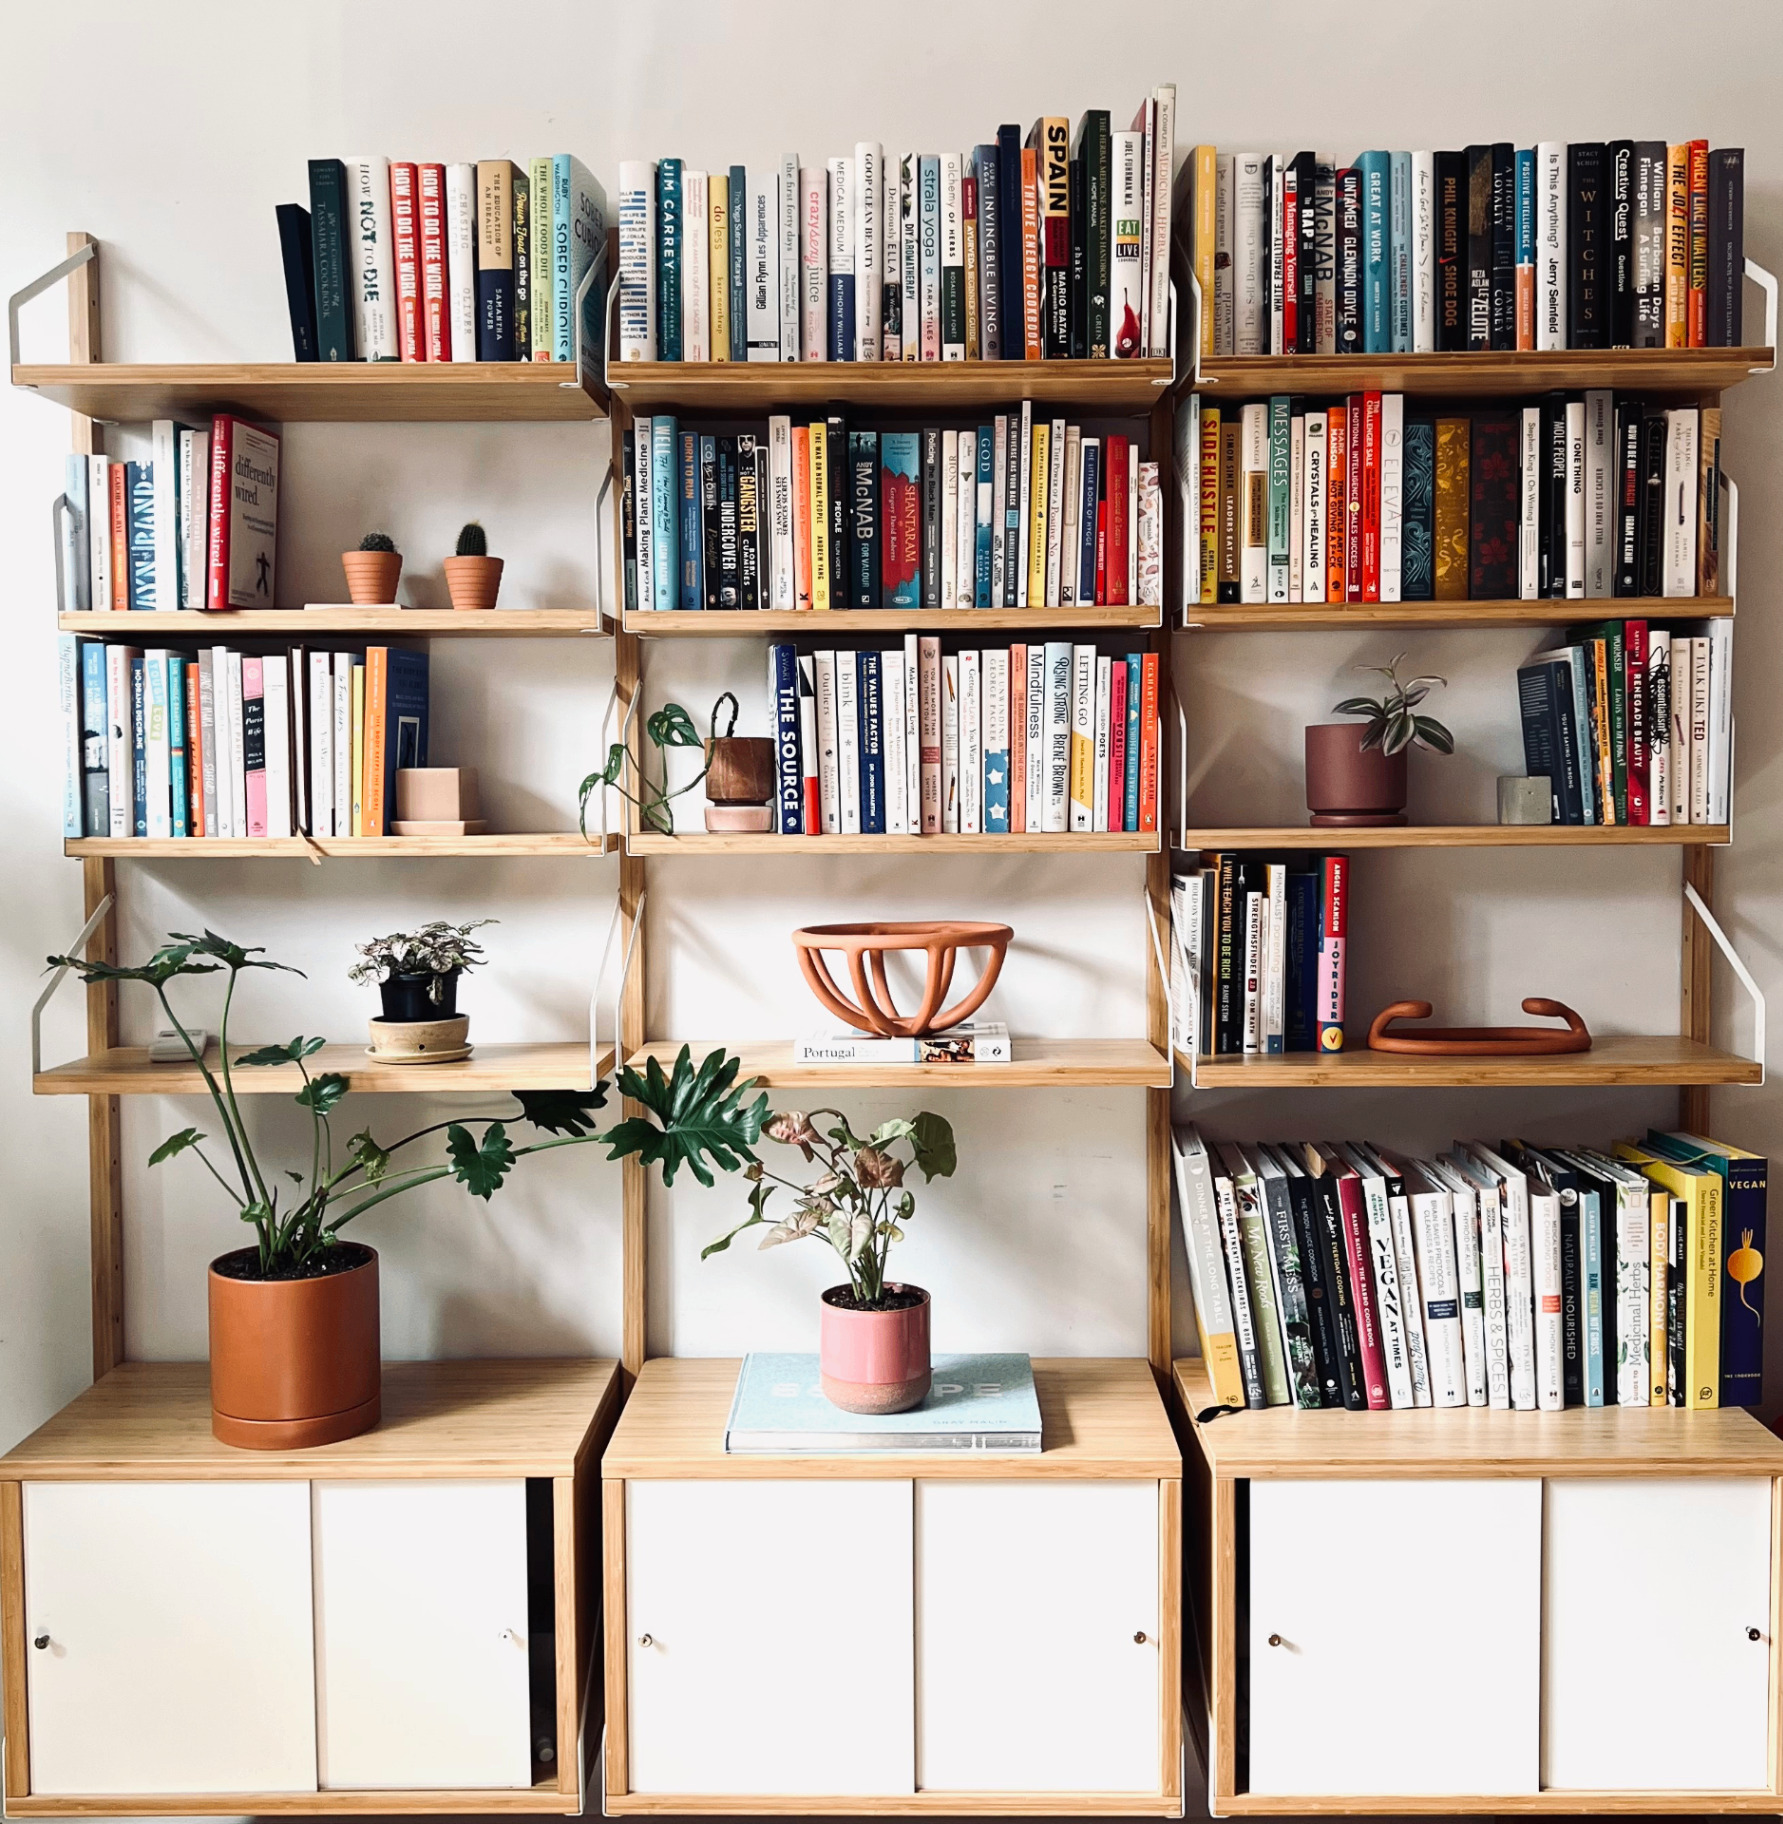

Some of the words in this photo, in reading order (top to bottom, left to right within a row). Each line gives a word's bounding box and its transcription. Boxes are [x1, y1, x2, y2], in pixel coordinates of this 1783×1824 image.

[865, 154, 873, 185] GOOP
[1048, 125, 1066, 211] SPAIN
[1550, 154, 1558, 163] Is
[1618, 149, 1629, 200] Creative
[360, 164, 371, 197] HOW
[395, 168, 410, 196] HOW
[664, 162, 674, 191] JIM
[837, 162, 845, 207] MEDICAL
[925, 169, 936, 212] strala
[1371, 172, 1380, 207] GREAT
[1444, 177, 1456, 204] PHIL
[1550, 167, 1558, 190] This
[1638, 158, 1650, 216] Finnegan
[1653, 161, 1663, 211] William
[396, 199, 411, 215] TO
[714, 206, 724, 222] do
[756, 195, 766, 242] Apparences
[865, 188, 873, 223] CLEAN
[1024, 184, 1036, 228] THRIVE
[1344, 177, 1356, 228] UNTAMED
[1372, 212, 1381, 224] AT
[361, 201, 376, 243] NOT
[397, 218, 412, 234] DO
[664, 200, 674, 269] CARREY
[715, 226, 724, 249] less
[921, 218, 935, 257] yoga
[985, 196, 996, 277] INVINCIBLE
[1117, 220, 1139, 235] EAT
[1286, 202, 1296, 255] Managing
[1445, 207, 1456, 253] KNIGHT
[1548, 194, 1558, 248] Anything?
[1618, 203, 1629, 240] Quest
[364, 245, 373, 265] TO
[398, 237, 413, 259] THE
[756, 244, 765, 259] Les
[1117, 244, 1139, 257] LIVE
[1316, 197, 1333, 281] McNAB
[1371, 230, 1381, 262] WORK
[1640, 234, 1649, 243] A
[756, 261, 766, 283] Flynn
[1025, 234, 1036, 279] ENERGY
[1345, 237, 1355, 287] GLENNON
[1547, 258, 1558, 286] Jerry
[1637, 248, 1649, 294] Surfing
[1653, 227, 1662, 292] Barbarian
[363, 268, 379, 302] DIE
[400, 262, 416, 299] WORK
[1287, 257, 1296, 303] Yourself
[1445, 265, 1456, 296] SHOE
[756, 285, 766, 309] Gillian
[986, 284, 997, 333] LIVING
[1344, 291, 1356, 324] DOYLE
[1445, 300, 1456, 326] DOG
[1550, 289, 1558, 333] Seinfeld
[1639, 298, 1649, 321] Life
[1651, 297, 1661, 328] Days
[1027, 284, 1037, 347] COOKBOOK
[685, 436, 693, 462] BORN
[1202, 420, 1217, 461] SIDE
[1274, 404, 1287, 487] MESSAGES
[1527, 423, 1535, 452] Stephen
[1553, 421, 1564, 446] MOLE
[685, 465, 693, 476] TO
[981, 438, 990, 472] GOD
[1526, 455, 1534, 472] King
[1553, 448, 1564, 478] PEOPLE
[211, 445, 225, 520] differently
[685, 479, 693, 499] RUN
[1311, 451, 1319, 508] CRYSTALS
[1528, 480, 1534, 491] On
[640, 498, 648, 525] Plant
[856, 468, 873, 539] McNAB
[888, 487, 896, 513] Gregory
[1202, 466, 1216, 533] HUSTLE
[1383, 459, 1402, 545] ELEVATE
[1526, 494, 1534, 521] Writing
[721, 501, 736, 570] UNDERCOVER
[905, 485, 915, 563] SHANTARAM
[212, 527, 223, 567] wired
[640, 530, 648, 567] Making
[1310, 519, 1319, 568] HEALING
[1053, 657, 1069, 689] RISING
[1079, 655, 1088, 704] LETTING
[1695, 656, 1705, 687] TALK
[780, 687, 793, 722] THE
[822, 673, 831, 715] Outliers
[841, 673, 852, 707] blink
[869, 678, 877, 715] VALUES
[1030, 654, 1042, 738] Mindfulness
[1695, 689, 1704, 718] LIKE
[1053, 692, 1068, 724] STRONG
[1079, 708, 1087, 726] GO
[870, 719, 878, 754] FACTOR
[1694, 720, 1705, 740] TED
[1053, 734, 1067, 761] BRENÉ
[783, 731, 798, 810] SOURCE
[1052, 765, 1065, 796] BROWN
[1223, 866, 1232, 886] WILL
[1223, 887, 1232, 913] TEACH
[1223, 916, 1231, 932] YOU
[1223, 934, 1230, 943] TO
[1250, 898, 1258, 974] STRENGTHSFINDER
[1222, 946, 1230, 957] BE
[1222, 959, 1230, 978] RICH
[1331, 941, 1339, 1019] JOYRIDER
[804, 1047, 855, 1058] Portugal
[1729, 1180, 1766, 1189] VEGAN
[1709, 1189, 1718, 1217] Green
[1246, 1226, 1259, 1247] My
[1277, 1211, 1290, 1248] FIRST
[1284, 1256, 1297, 1293] MESS
[1656, 1223, 1665, 1257] BODY
[1708, 1219, 1718, 1255] Kitchen
[1251, 1250, 1264, 1276] New
[1565, 1234, 1574, 1291] NATURALLY
[1709, 1257, 1716, 1266] at
[1255, 1280, 1270, 1309] Roots
[1488, 1266, 1501, 1318] HERBS
[1631, 1262, 1641, 1299] Herbs
[1655, 1262, 1664, 1330] HARMONY
[1708, 1269, 1716, 1297] Home
[1390, 1321, 1398, 1333] AT
[1491, 1325, 1501, 1335] &
[1566, 1296, 1575, 1359] NOURISHED
[1629, 1304, 1641, 1366] Medicinal
[1392, 1337, 1401, 1369] TIMES
[1492, 1338, 1505, 1393] SPICES
